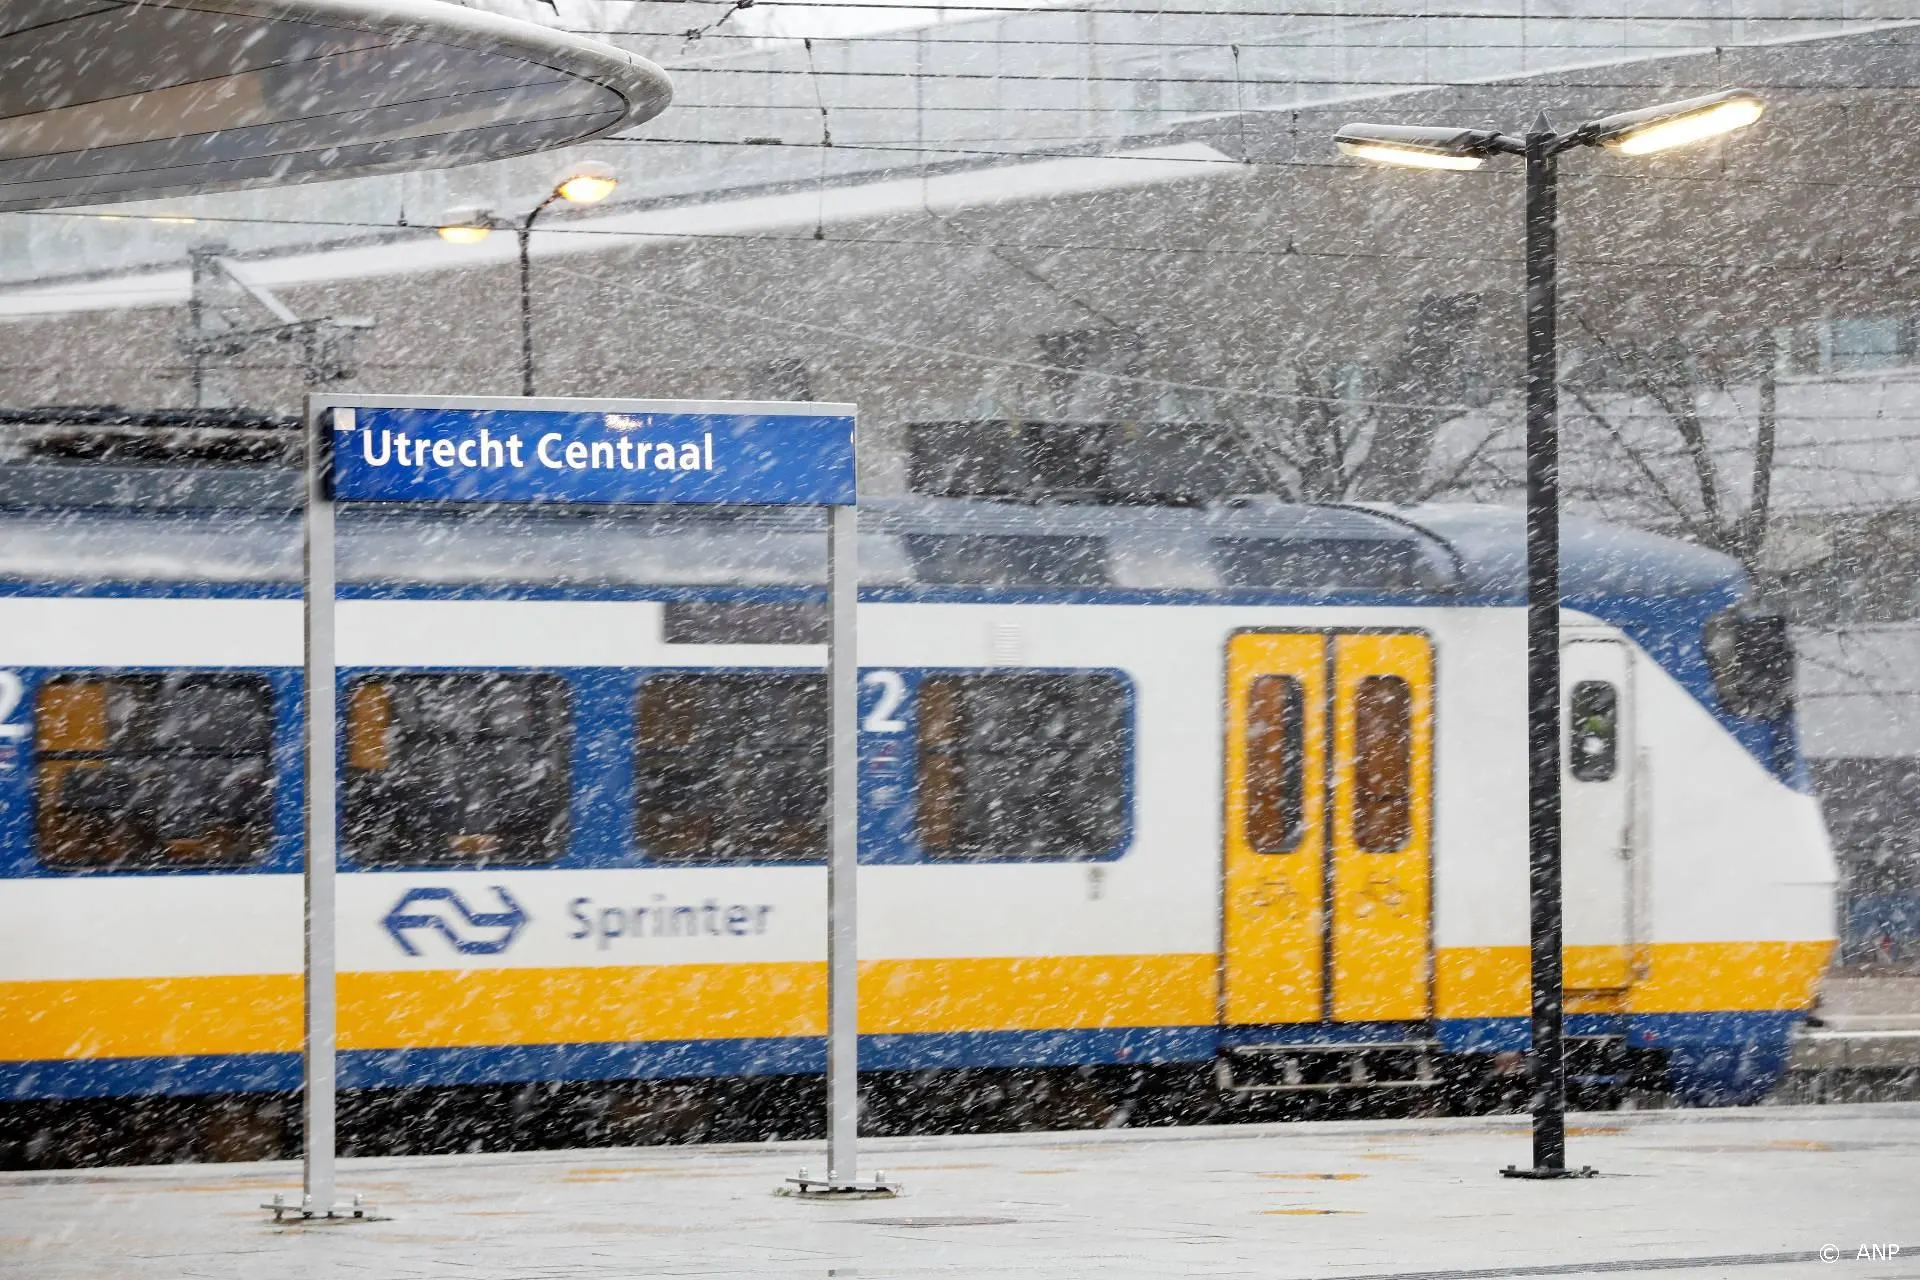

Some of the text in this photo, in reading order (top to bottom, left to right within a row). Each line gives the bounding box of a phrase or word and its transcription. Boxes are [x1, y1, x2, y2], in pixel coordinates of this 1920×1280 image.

[362, 428, 713, 471] Utrecht Centraal
[0, 670, 34, 737] 2
[862, 670, 906, 732] 2
[568, 894, 775, 950] Sprinter
